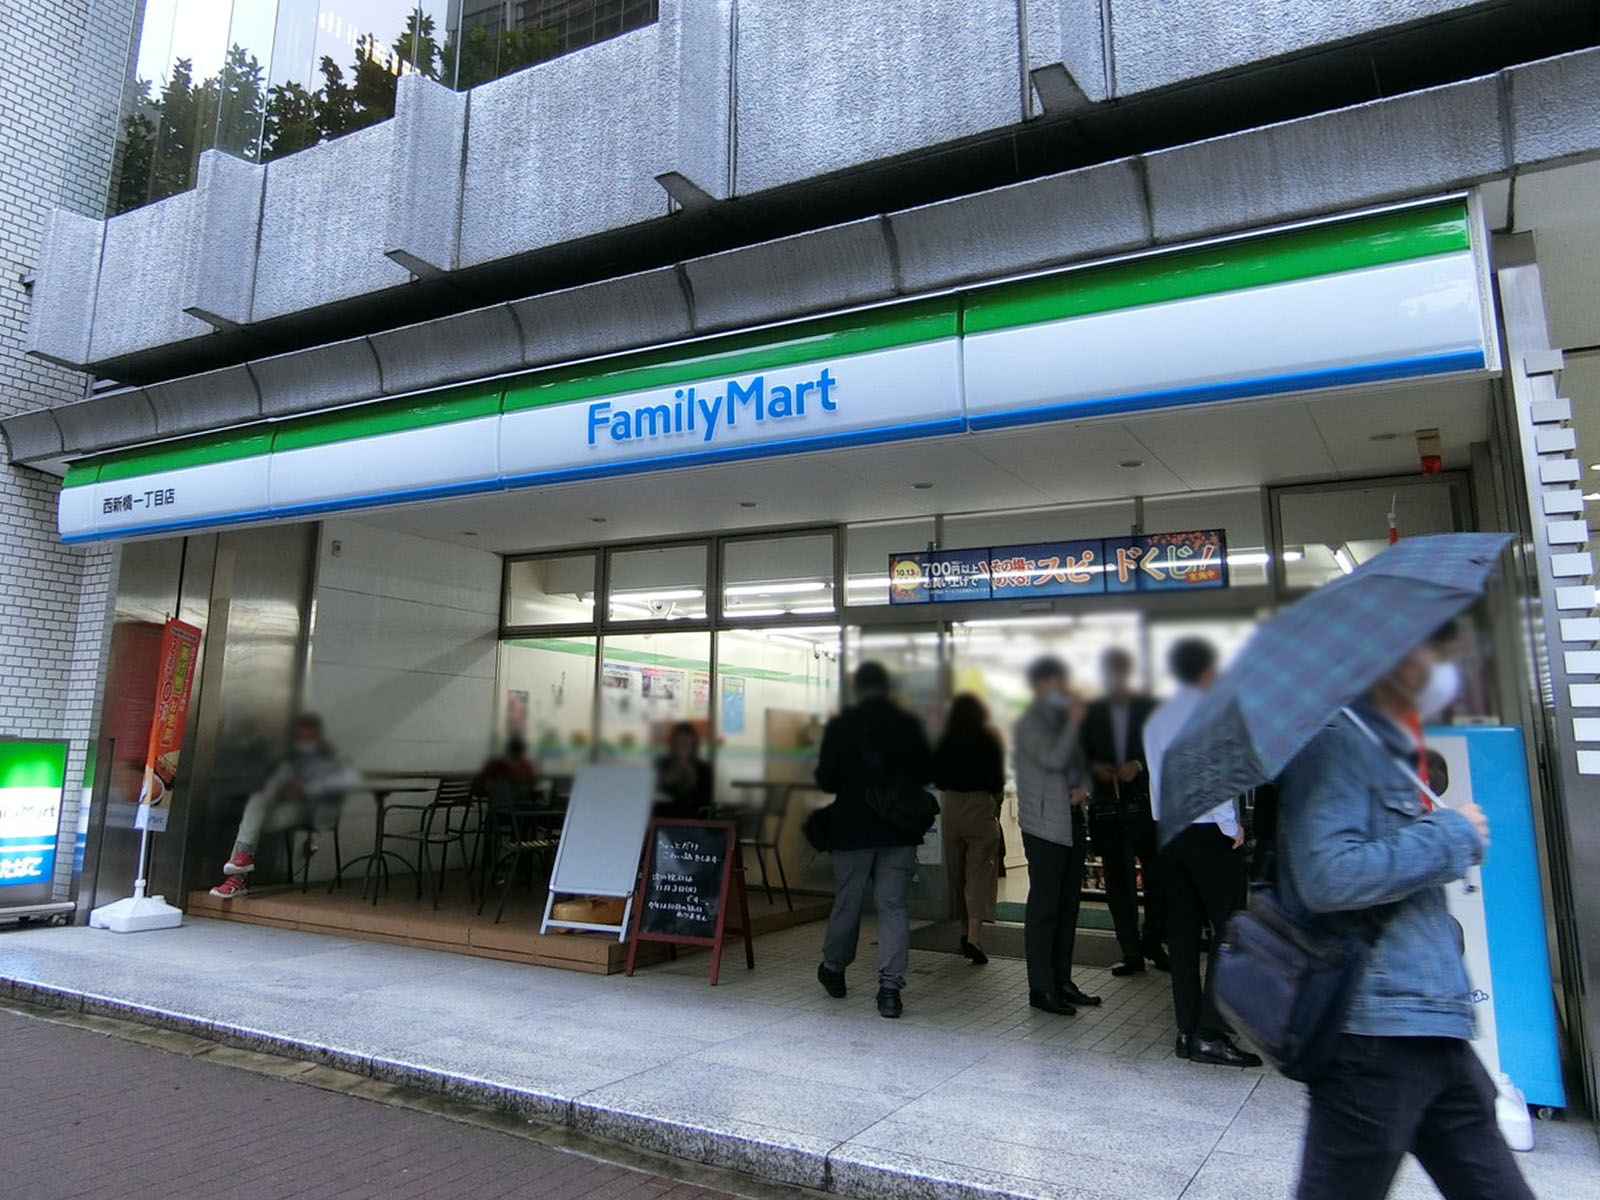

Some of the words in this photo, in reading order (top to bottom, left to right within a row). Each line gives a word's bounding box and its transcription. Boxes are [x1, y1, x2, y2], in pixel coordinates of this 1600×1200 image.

[587, 367, 837, 445] FamilyMart
[103, 488, 175, 514] 西新橋一丁目店
[922, 561, 979, 577] 700円以上
[991, 557, 1034, 573] その場で
